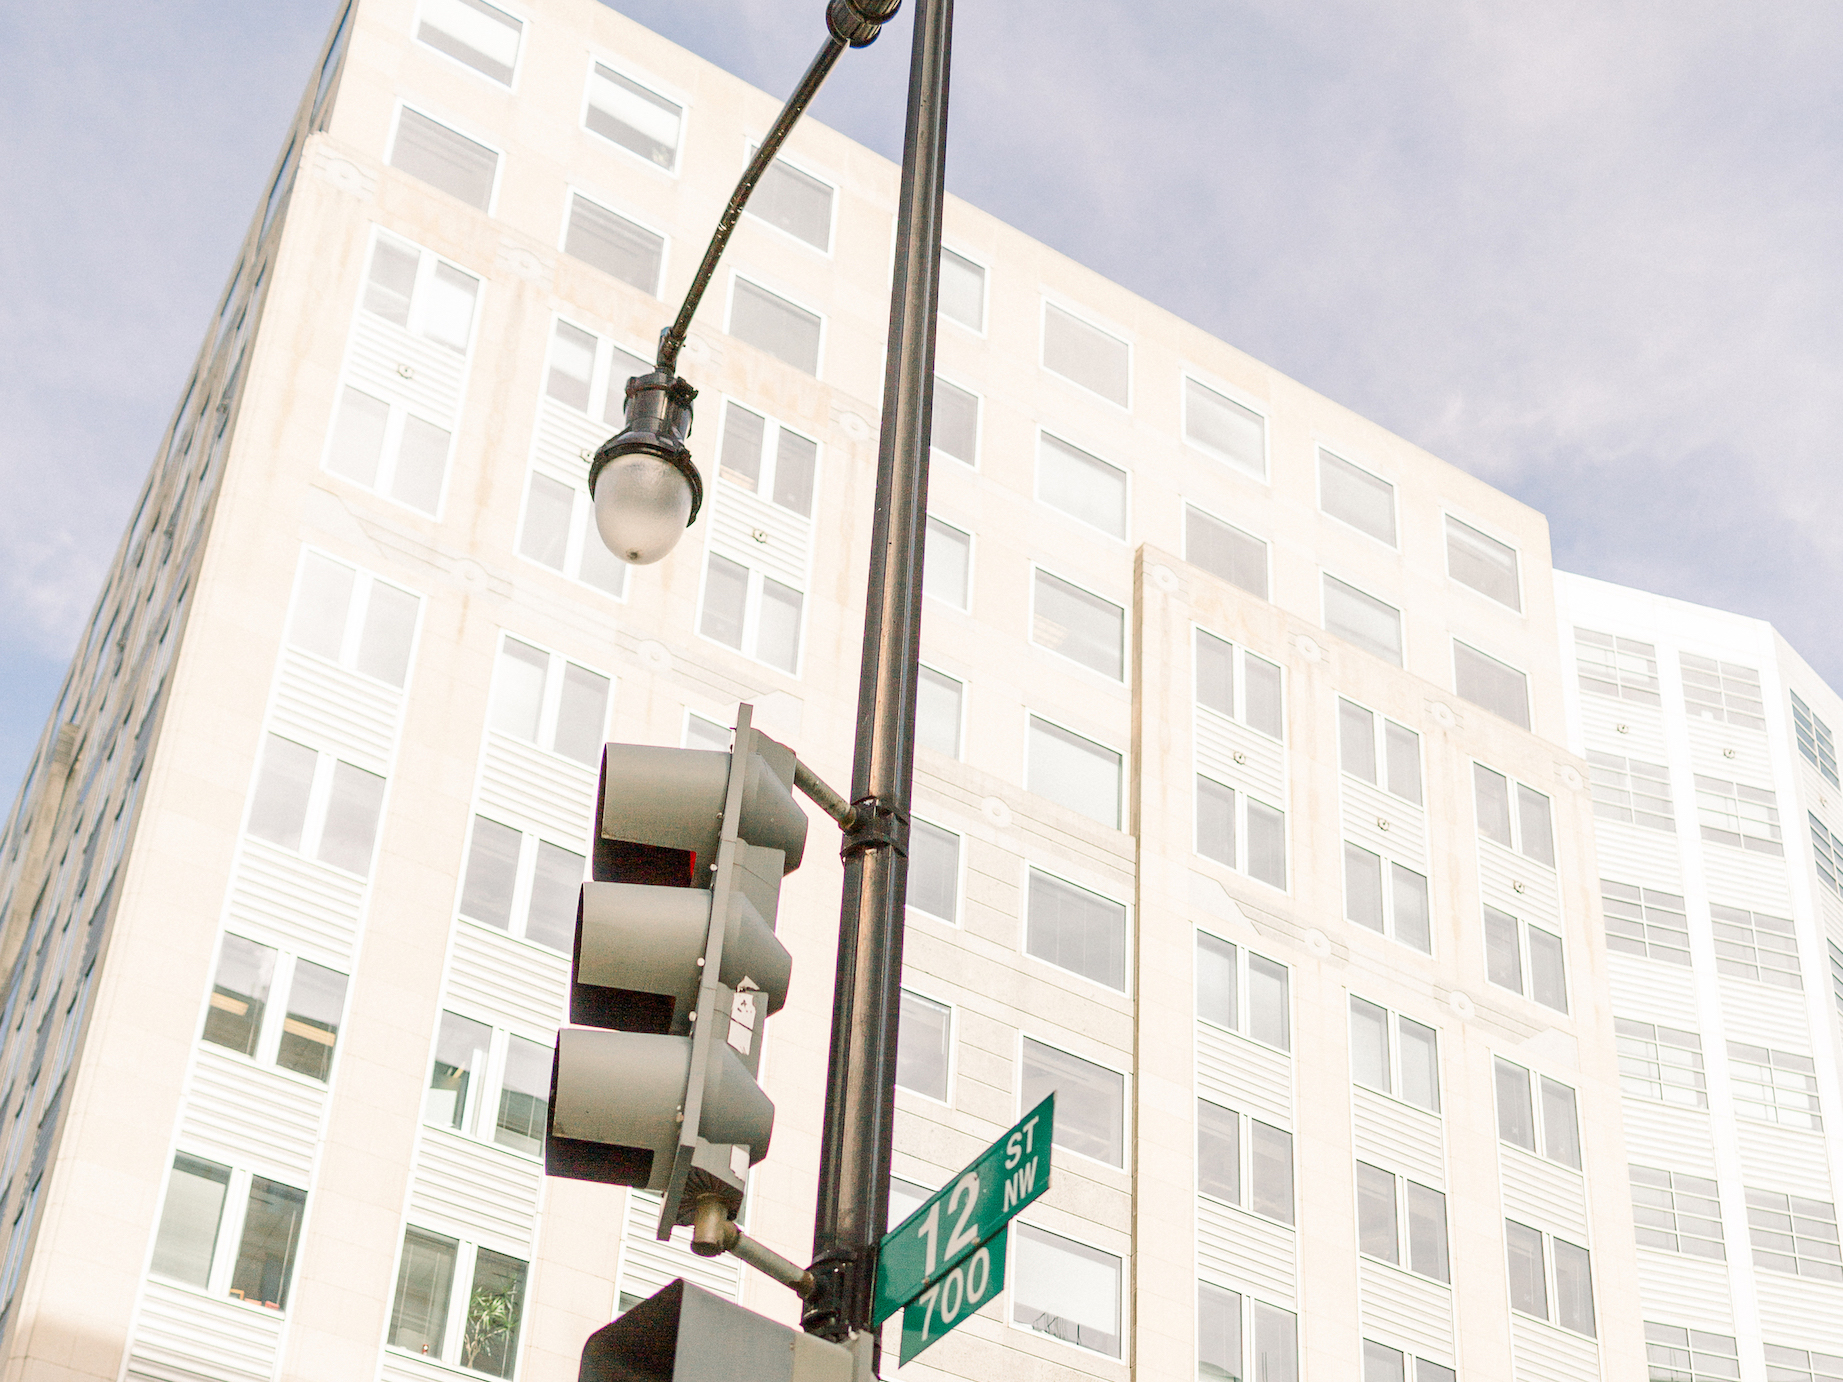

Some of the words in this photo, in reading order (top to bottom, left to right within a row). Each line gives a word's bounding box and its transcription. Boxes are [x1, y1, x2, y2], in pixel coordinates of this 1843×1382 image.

[1005, 1116, 1040, 1170] ST
[1003, 1155, 1038, 1213] NW
[918, 1171, 981, 1278] 12
[919, 1246, 990, 1342] 700
